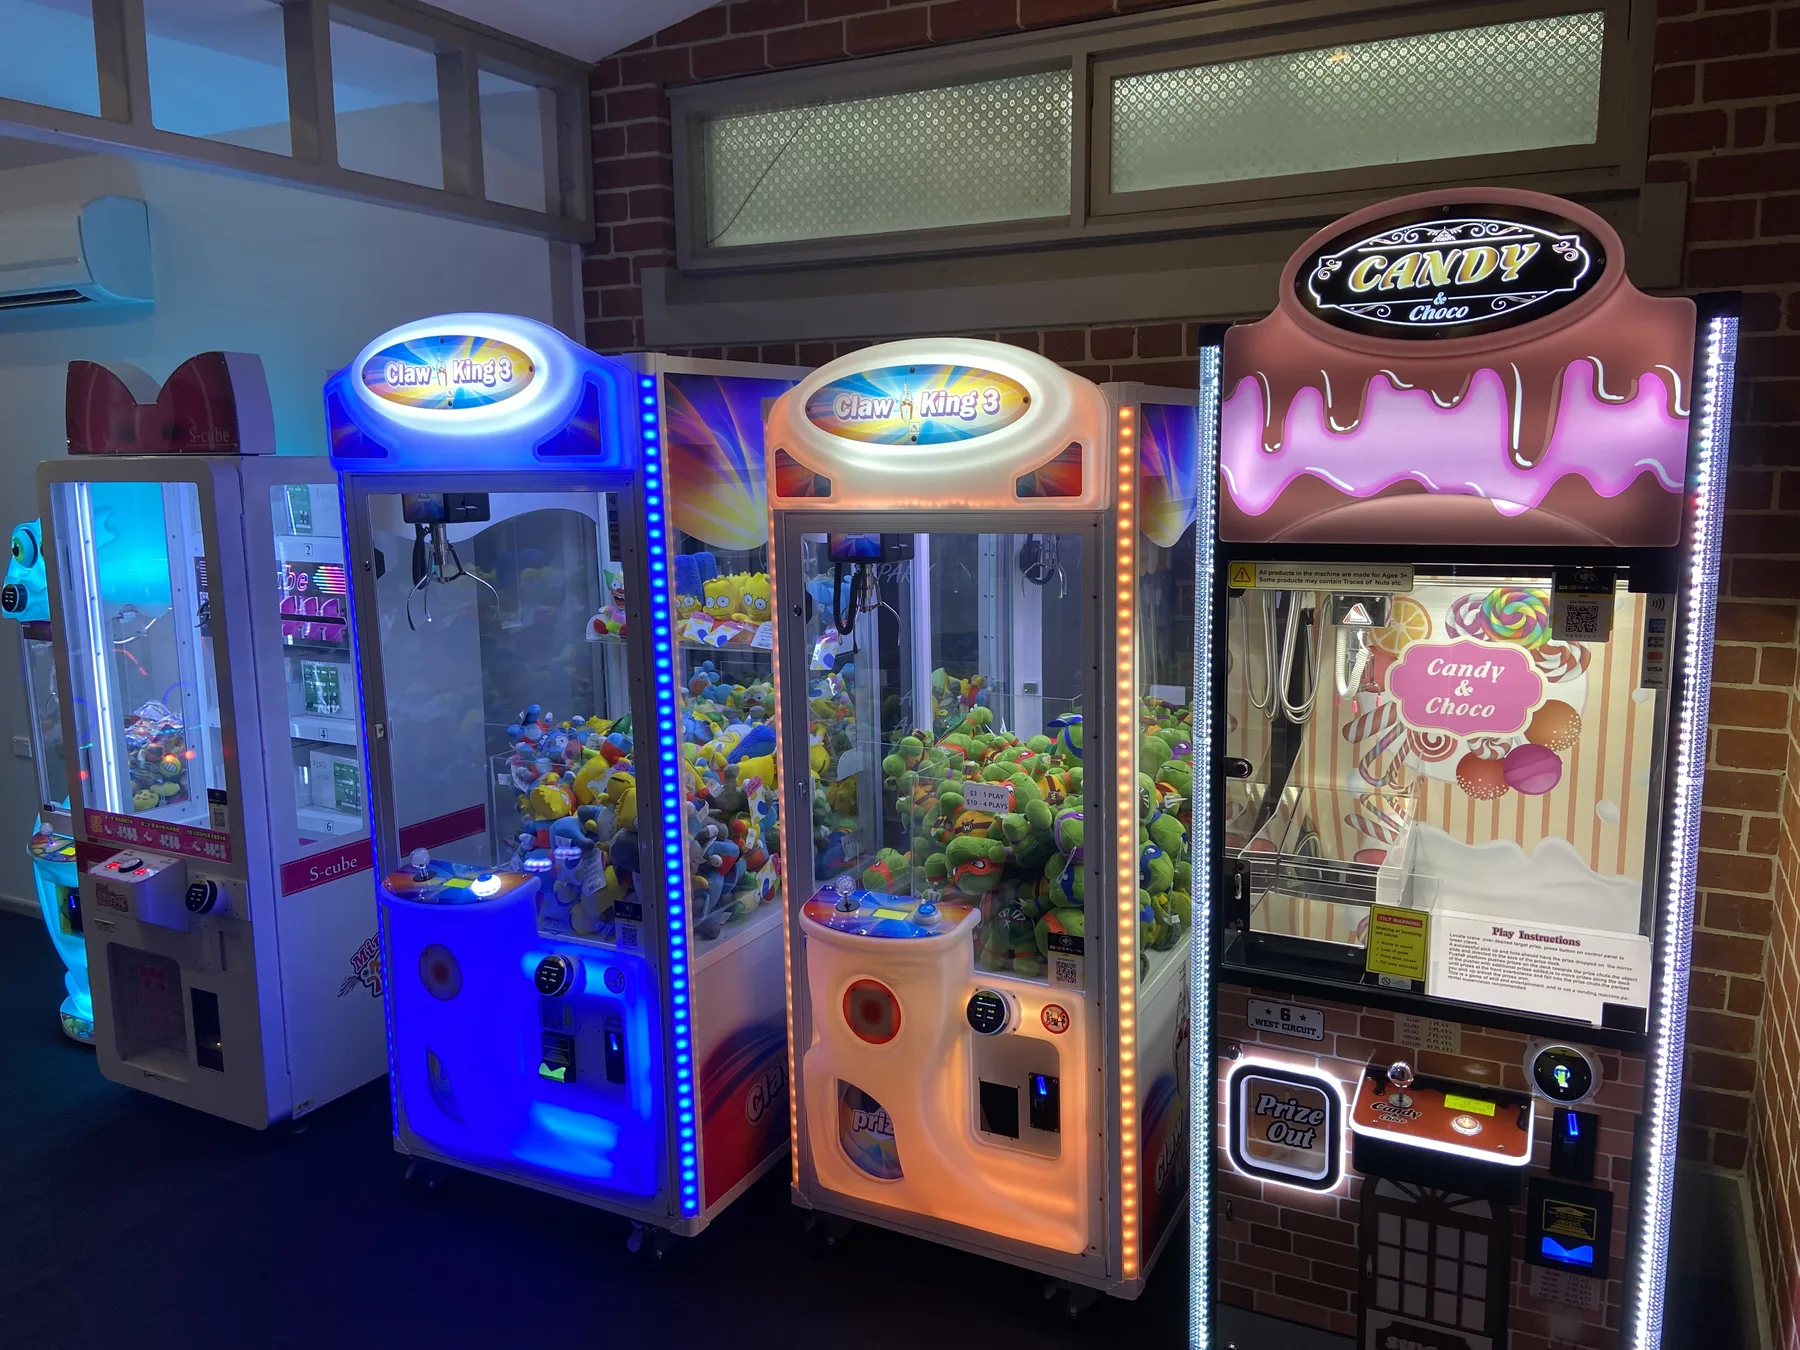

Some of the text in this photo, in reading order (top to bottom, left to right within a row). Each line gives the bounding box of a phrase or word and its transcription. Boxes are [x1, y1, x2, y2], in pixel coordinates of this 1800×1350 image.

[1349, 243, 1540, 292] CANDY
[1434, 292, 1446, 305] &
[1410, 304, 1469, 321] Choco
[386, 356, 512, 387] Claw King 3
[834, 388, 1000, 421] Claw King 3
[306, 546, 310, 554] 2
[1427, 658, 1505, 683] Candy
[1454, 680, 1474, 696] &
[1425, 696, 1496, 718] Choco
[327, 822, 332, 832] 6
[310, 857, 358, 881] S-cube
[1393, 917, 1420, 926] WARNING
[1492, 927, 1580, 946] Play Instructions
[1280, 1008, 1291, 1021] 6
[1255, 1018, 1316, 1035] WEST CIRCUIT
[1256, 1094, 1324, 1125] Prize
[1371, 1102, 1422, 1119] Candy
[1266, 1122, 1316, 1148] Out
